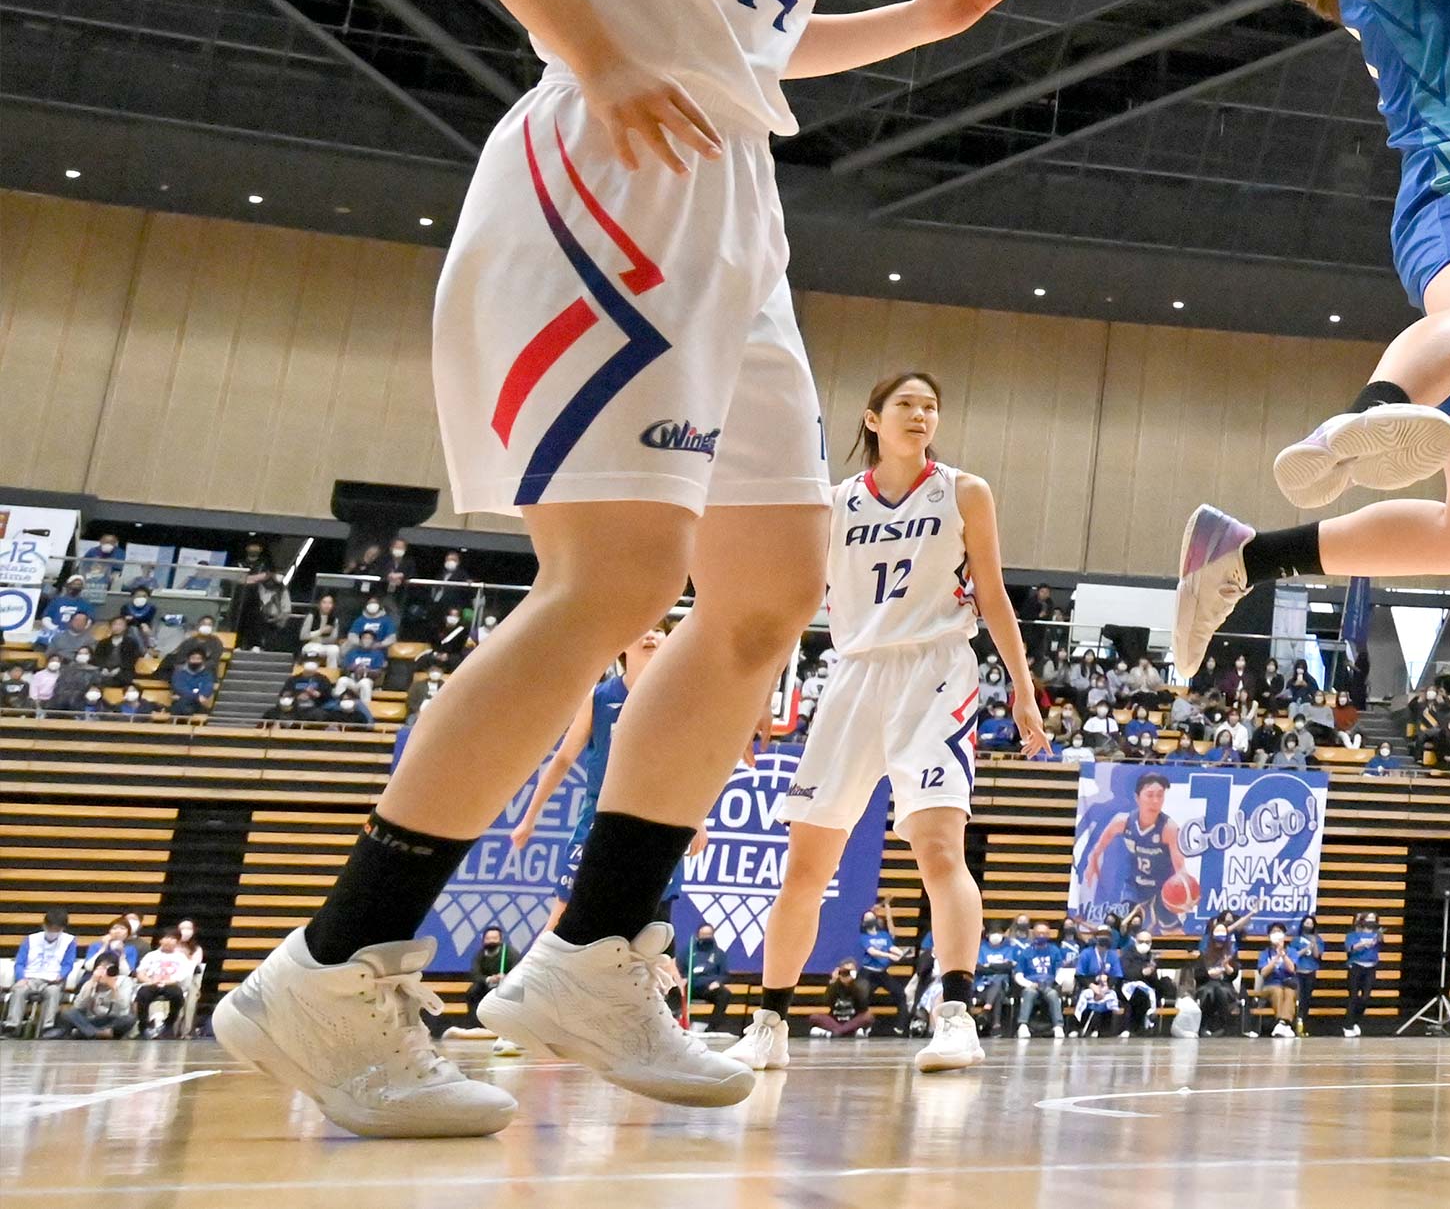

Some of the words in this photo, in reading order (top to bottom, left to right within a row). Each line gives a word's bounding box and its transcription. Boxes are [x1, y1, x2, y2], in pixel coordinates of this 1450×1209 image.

[845, 517, 941, 546] AISIN
[10, 541, 36, 563] 12
[871, 559, 912, 604] 12
[920, 766, 944, 789] 12
[1228, 856, 1313, 886] NAKO
[1206, 888, 1310, 913] Motohashi
